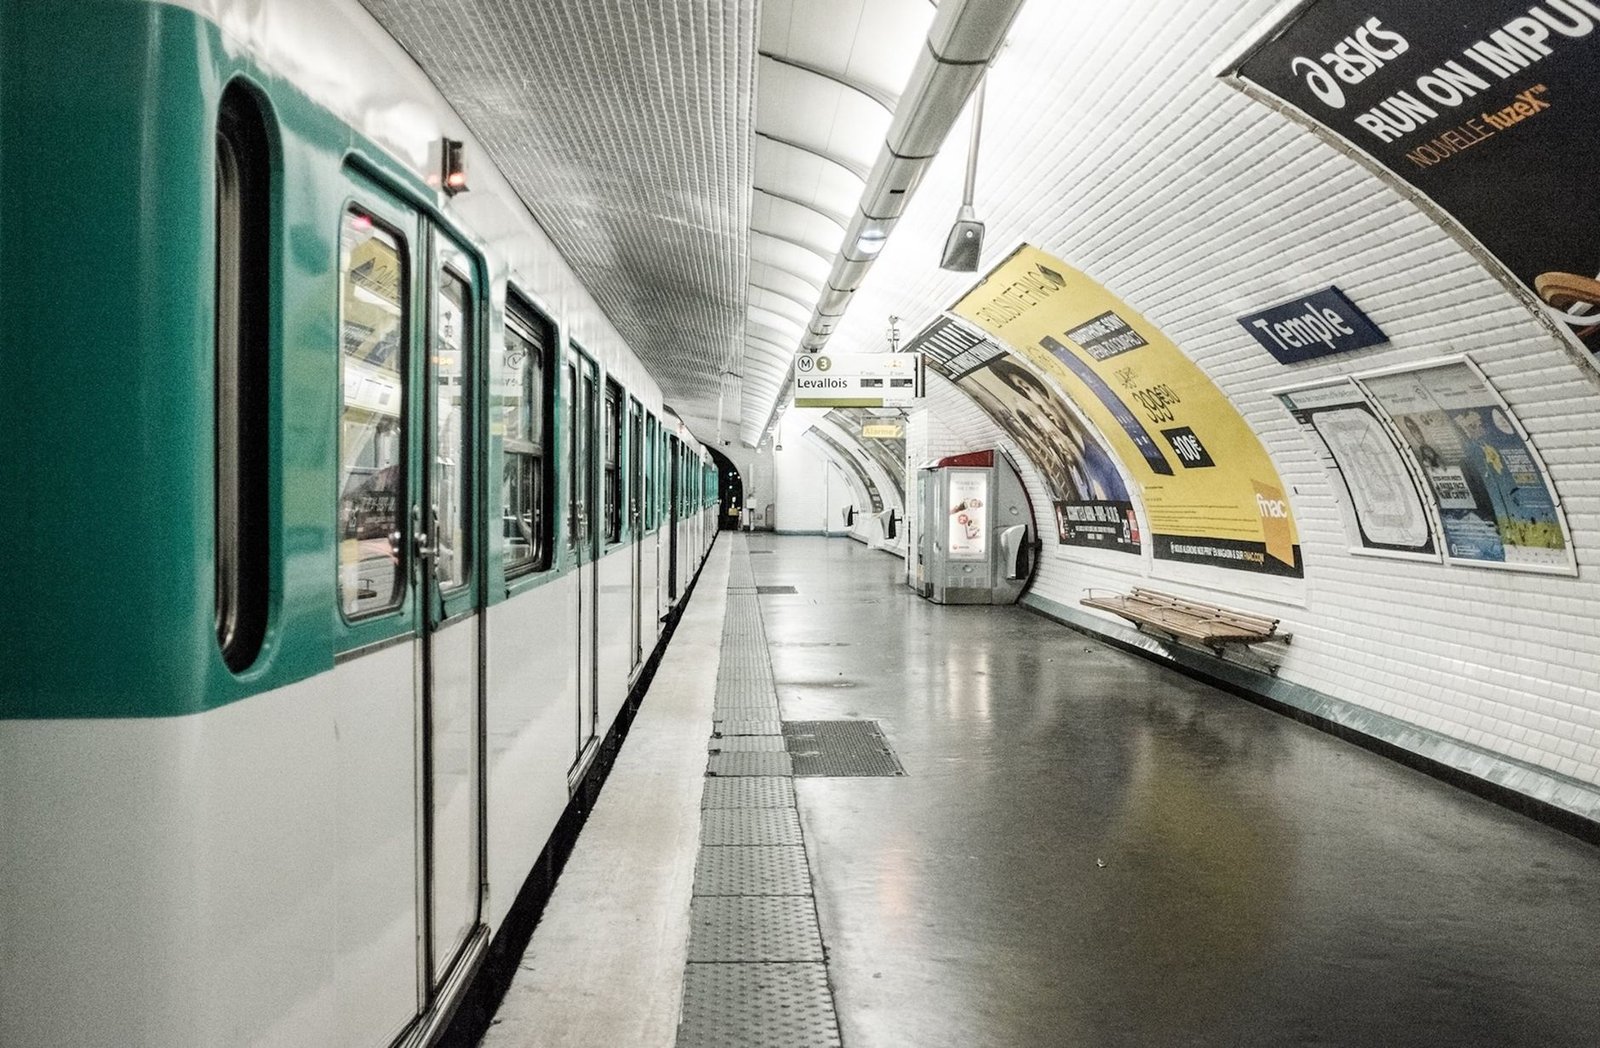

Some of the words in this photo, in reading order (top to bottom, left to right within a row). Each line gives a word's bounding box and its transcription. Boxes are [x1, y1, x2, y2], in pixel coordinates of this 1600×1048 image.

[1354, 90, 1439, 144] RUN
[1416, 60, 1491, 107] ON
[1463, 0, 1600, 79] IMPU
[1406, 118, 1495, 168] NOUVELLE
[1255, 302, 1354, 350] Temple
[797, 378, 848, 388] Levallois
[864, 427, 894, 436] Alarme
[1256, 492, 1287, 518] fnac
